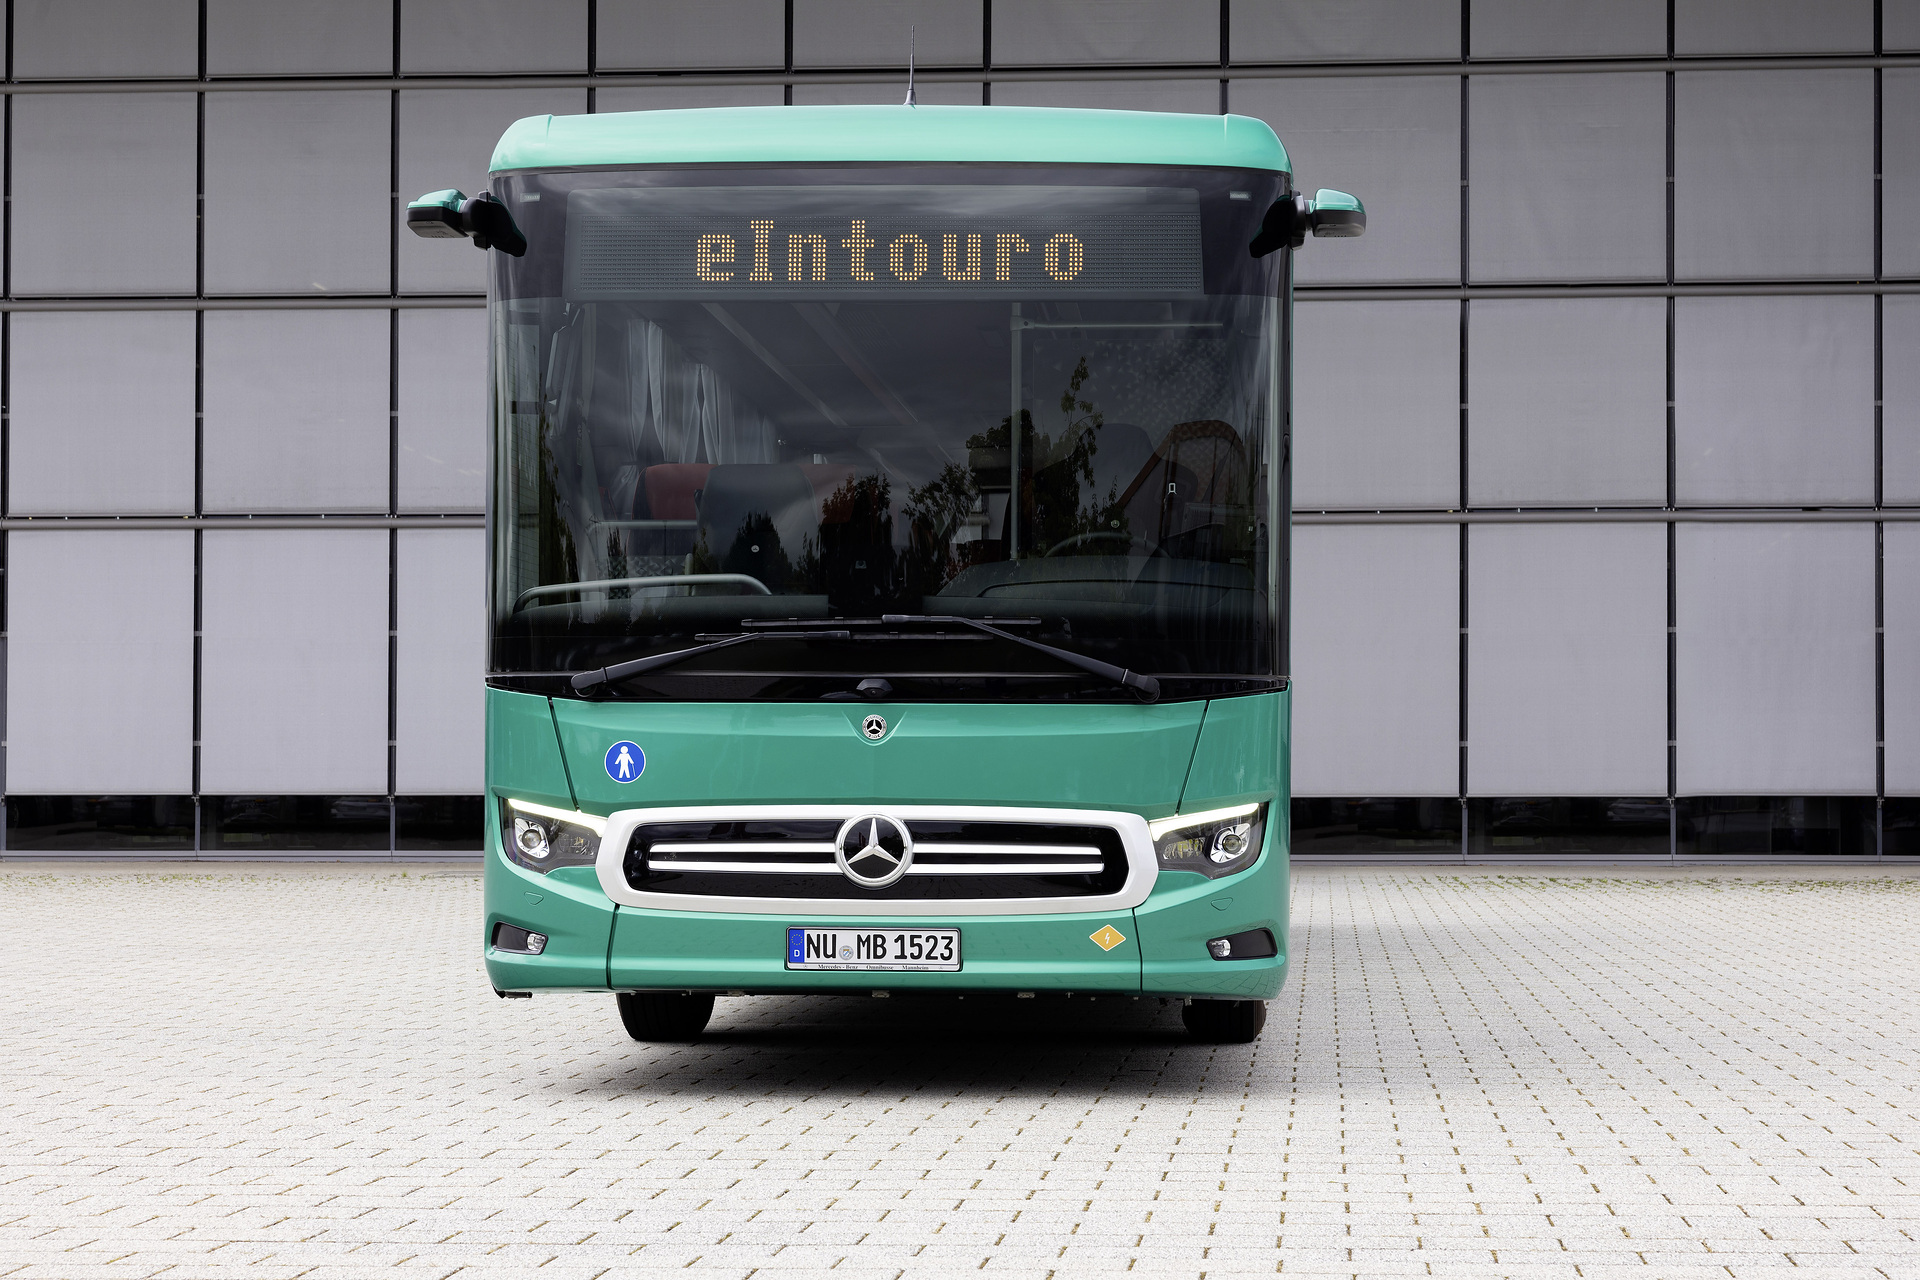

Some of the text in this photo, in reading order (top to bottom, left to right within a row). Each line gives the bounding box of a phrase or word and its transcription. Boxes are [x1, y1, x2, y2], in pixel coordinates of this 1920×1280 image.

[696, 219, 1084, 282] eIntouro
[793, 949, 800, 957] D
[806, 933, 954, 961] NU MB 1523
